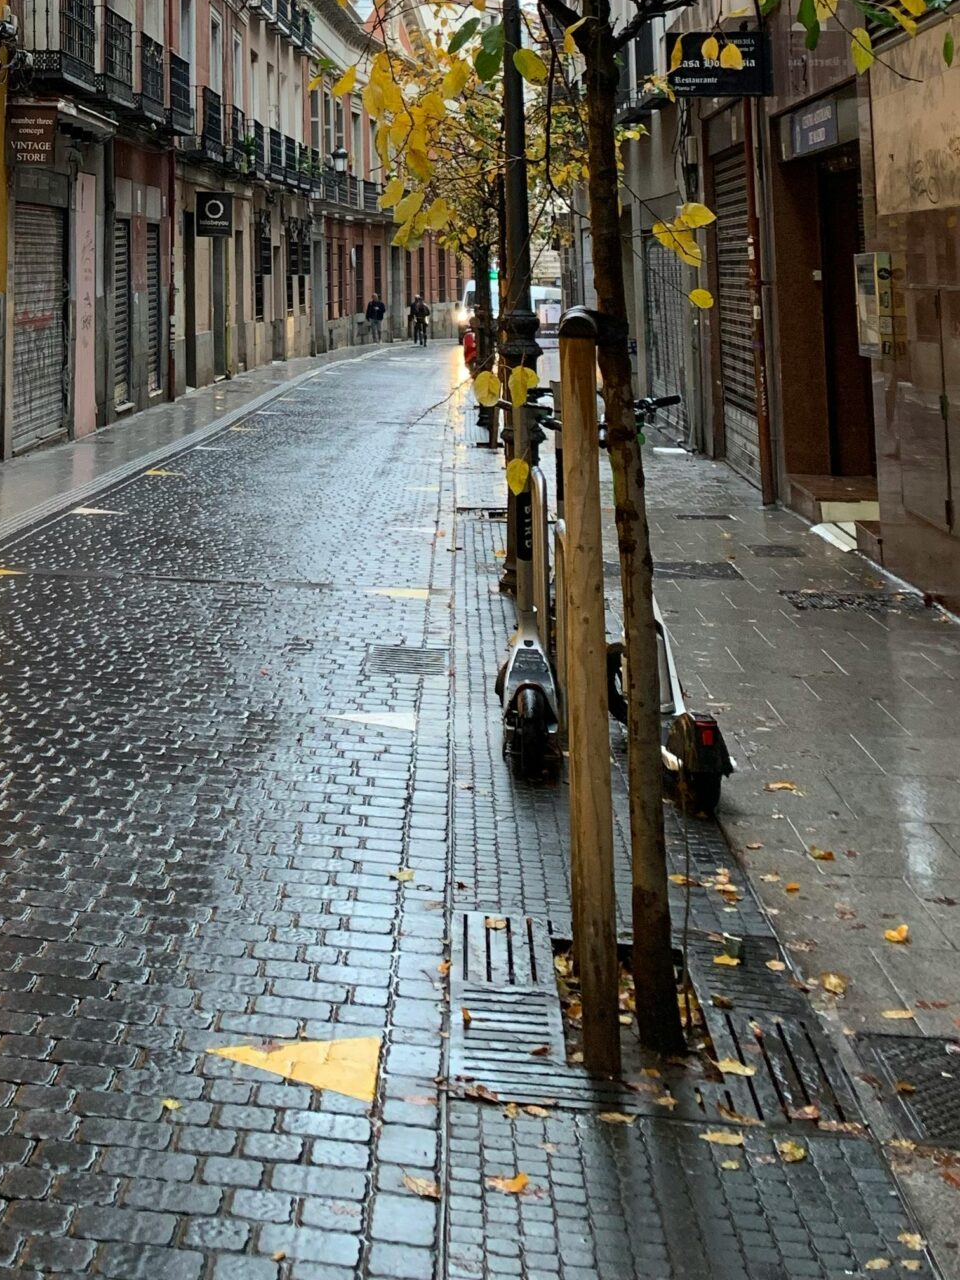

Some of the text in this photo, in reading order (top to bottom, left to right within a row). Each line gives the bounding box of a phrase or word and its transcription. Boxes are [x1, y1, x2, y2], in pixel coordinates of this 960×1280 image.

[681, 59, 700, 67] asa
[36, 117, 53, 125] three
[19, 127, 44, 136] concept
[11, 141, 52, 150] VINTAGE
[16, 152, 47, 162] STORE
